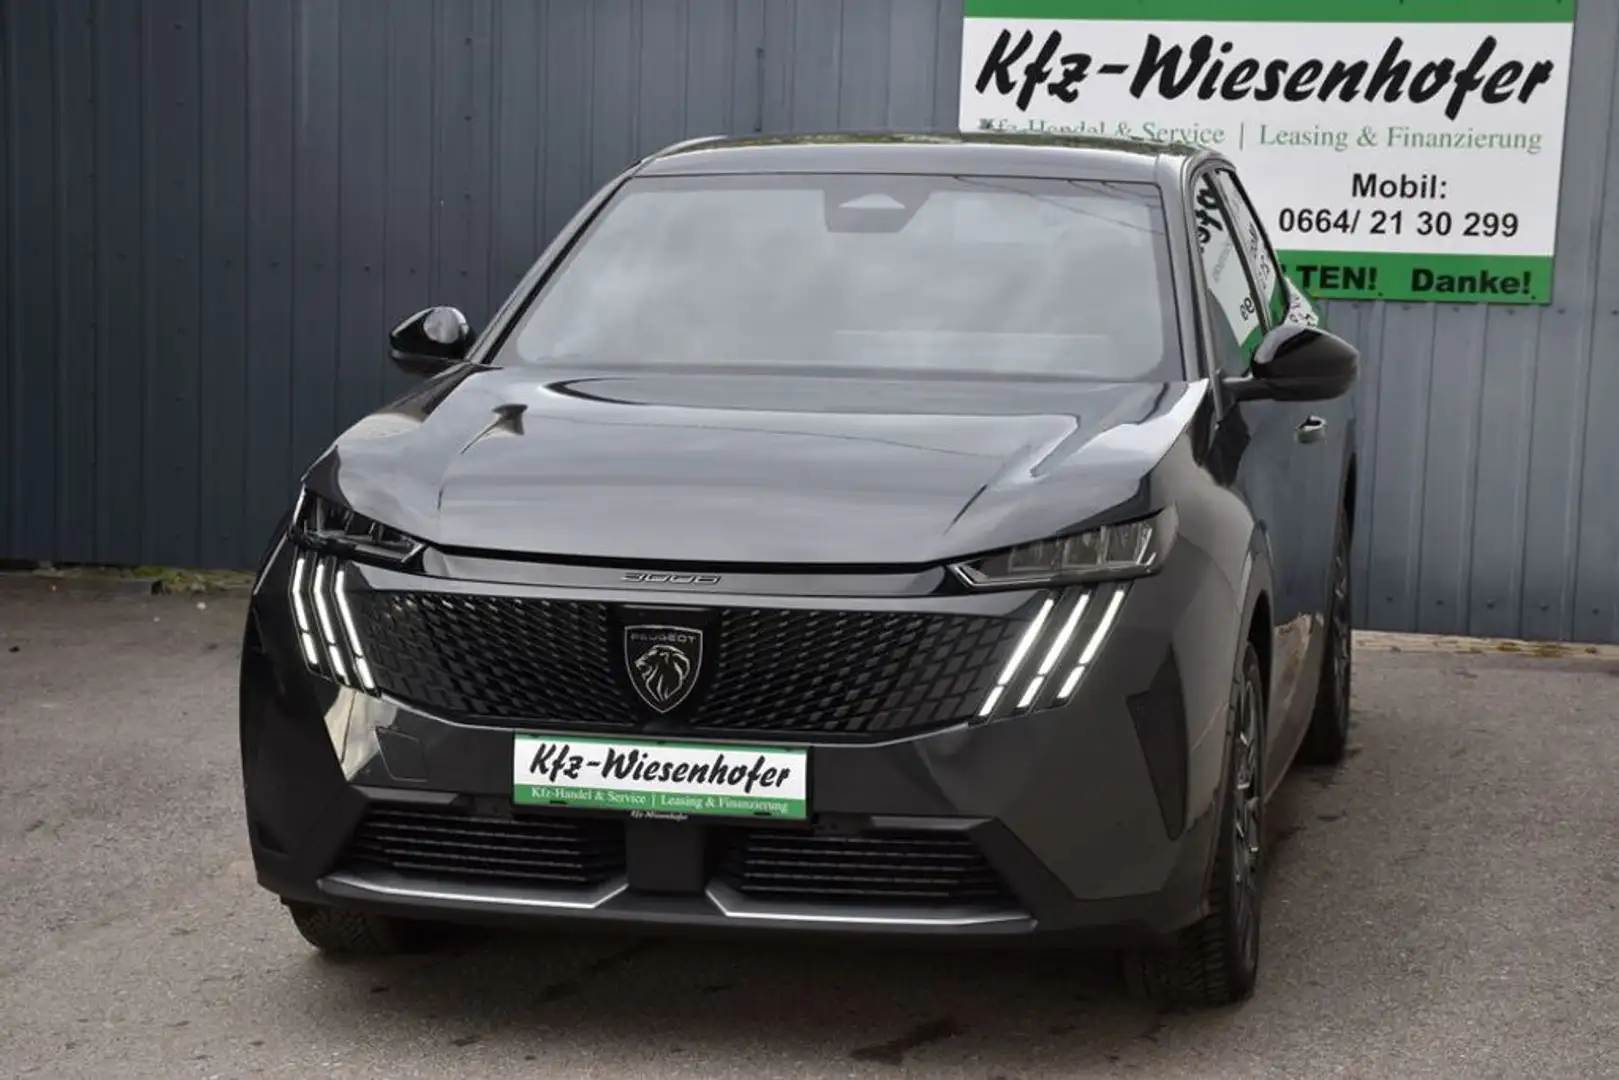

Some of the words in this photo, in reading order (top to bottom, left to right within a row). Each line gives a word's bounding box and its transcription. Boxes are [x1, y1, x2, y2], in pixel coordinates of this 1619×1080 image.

[974, 28, 1554, 119] Kfz-Wiesenhofer
[1142, 121, 1225, 144] Service
[1259, 124, 1348, 151] Leasing
[1356, 125, 1378, 147] &
[1387, 126, 1543, 154] Finanzierung
[1351, 173, 1447, 199] Mobil:
[1278, 208, 1361, 234] 0664/
[1369, 209, 1403, 235] 21
[1416, 210, 1452, 236] 30
[1463, 211, 1519, 238] 299
[1282, 265, 1377, 291] TEN!
[1411, 268, 1532, 296] Danke!
[630, 632, 696, 643] PEUGEOT
[529, 743, 791, 794] Kfz-Wiesenhofer
[531, 786, 592, 801] Kfz-Handel
[594, 790, 605, 801] &
[607, 790, 647, 805] Service
[661, 794, 703, 810] Leasing
[705, 796, 715, 808] &
[719, 796, 789, 814] Finanzierung
